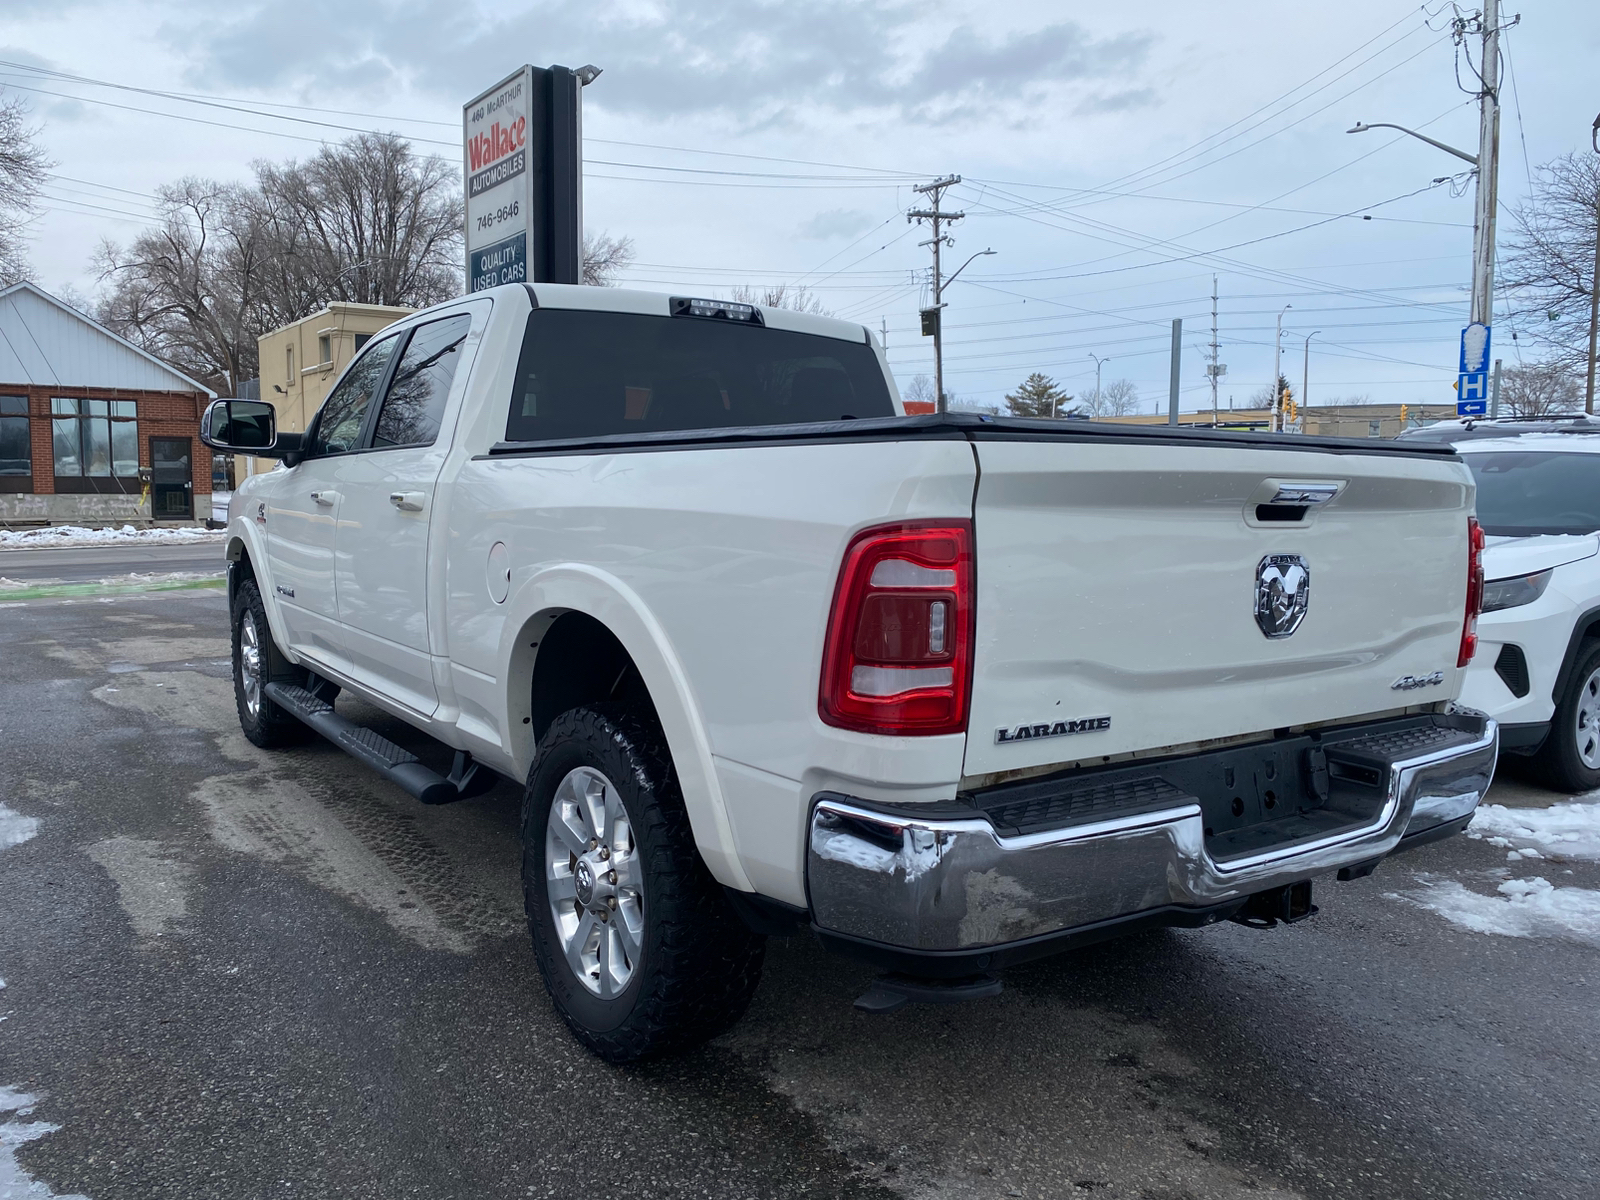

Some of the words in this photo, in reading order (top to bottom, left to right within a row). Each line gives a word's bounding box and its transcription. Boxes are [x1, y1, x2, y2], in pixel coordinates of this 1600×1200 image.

[471, 107, 485, 123] 460
[487, 83, 522, 115] McARTHUR
[468, 115, 526, 172] Wallace
[472, 154, 524, 193] AUTOMOBILES
[477, 201, 519, 231] 746-9646
[480, 245, 516, 271] QUALITY
[473, 272, 498, 291] USED
[501, 261, 525, 283] CARS
[1462, 374, 1484, 399] H
[1269, 556, 1301, 565] RAM
[994, 713, 1112, 745] LARAMIE
